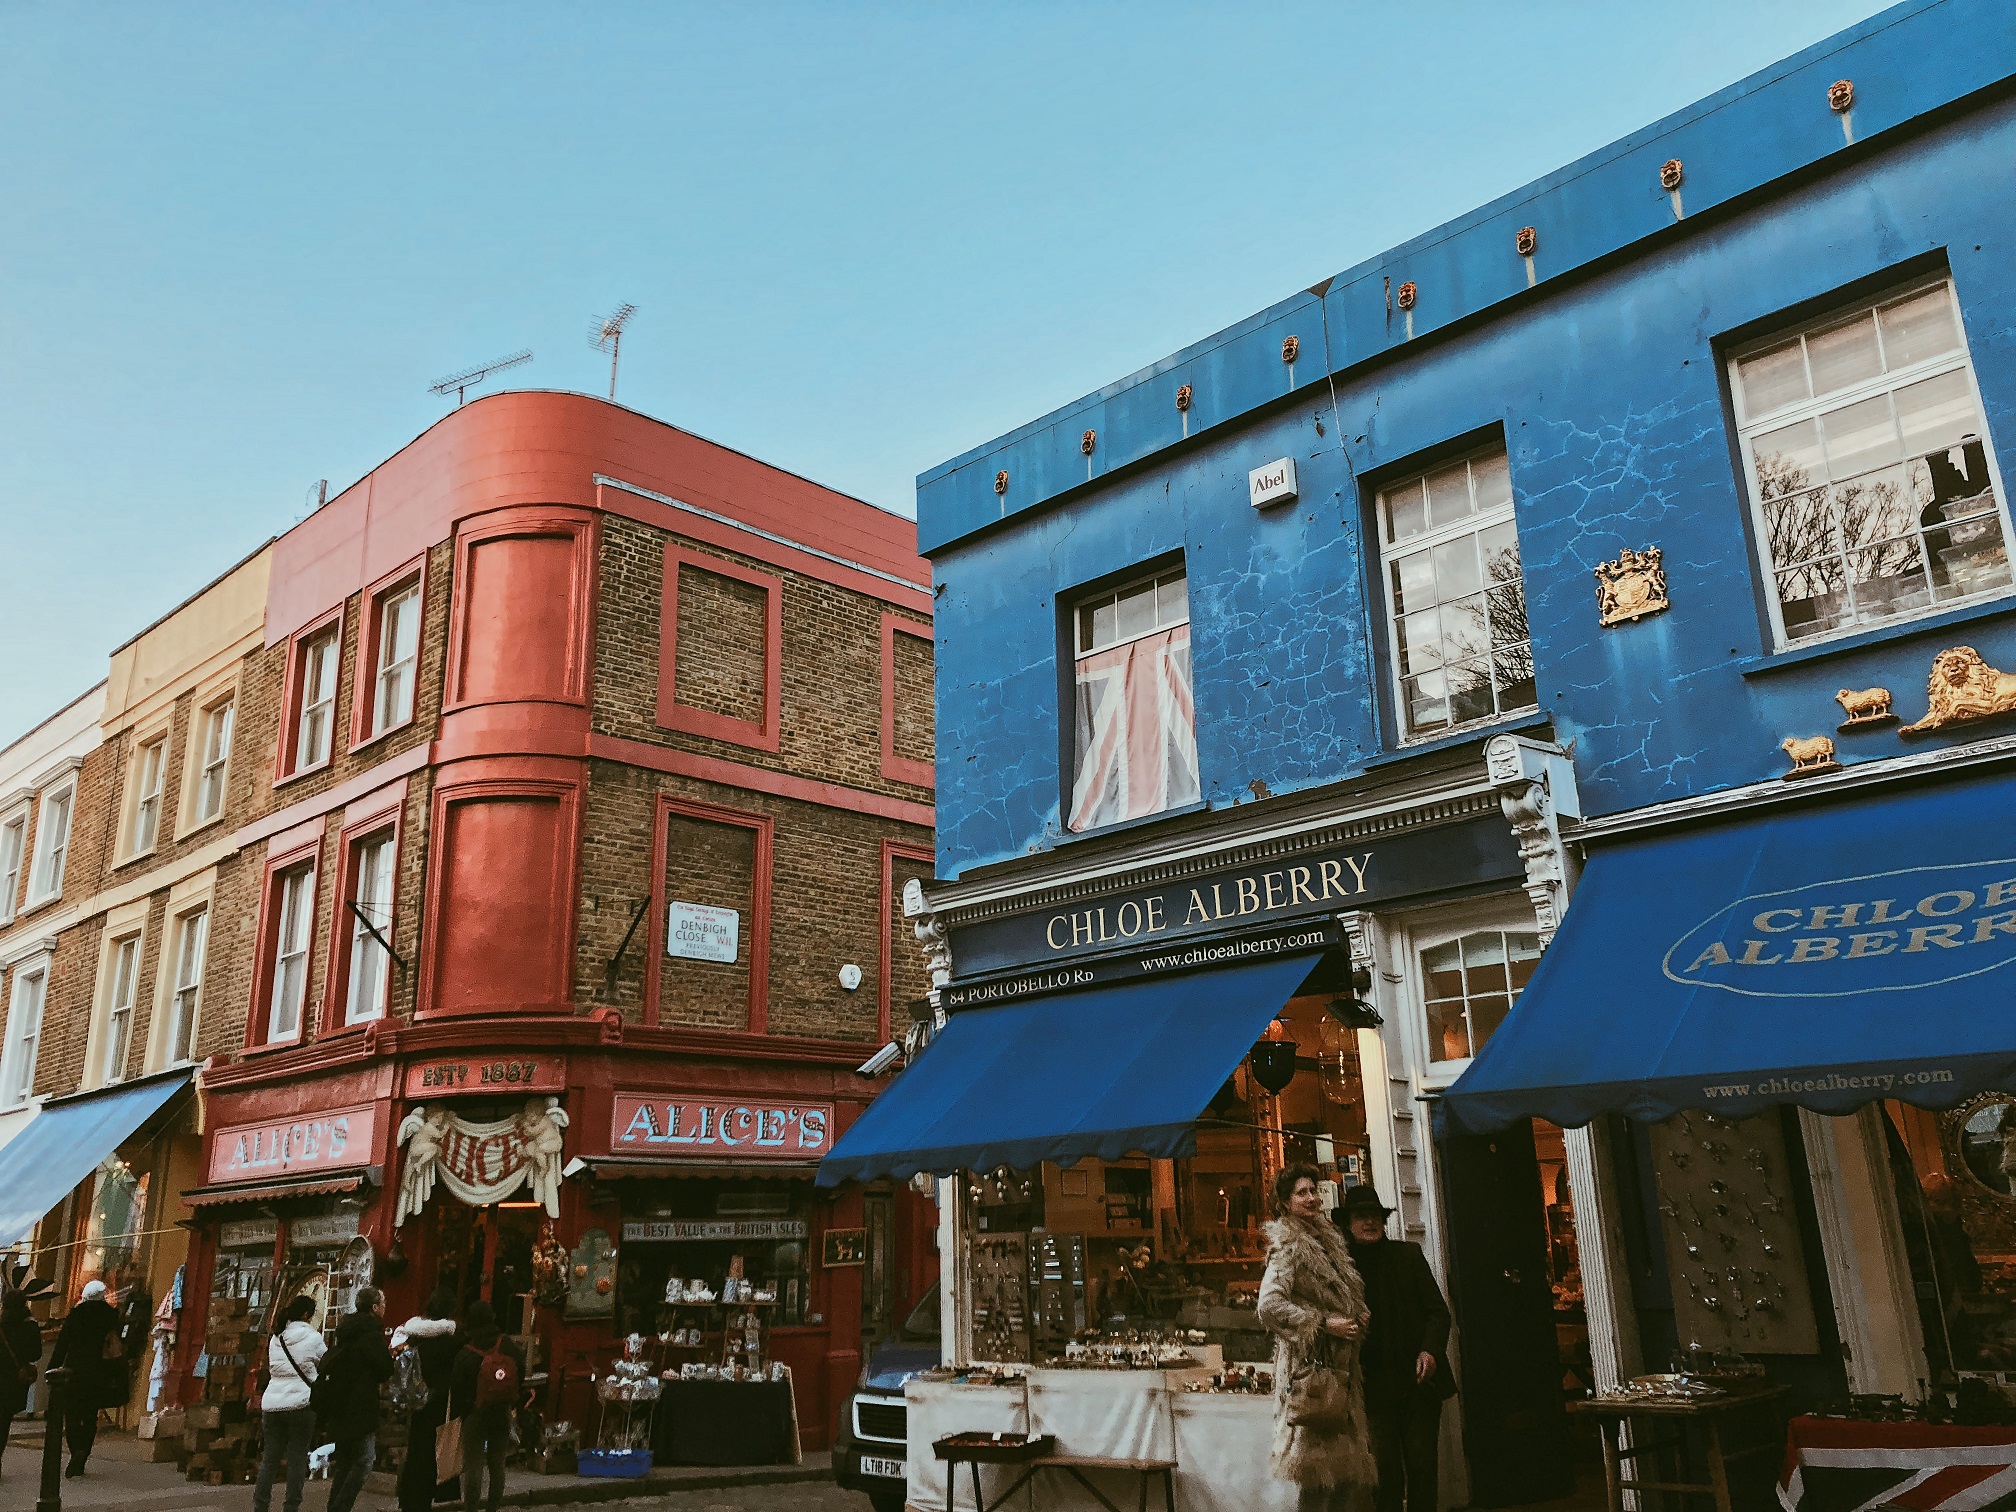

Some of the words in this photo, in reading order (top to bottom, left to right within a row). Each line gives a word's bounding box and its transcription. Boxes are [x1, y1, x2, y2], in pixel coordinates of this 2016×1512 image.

[1254, 469, 1285, 494] Abel
[1045, 895, 1168, 951] CHLOE
[1183, 851, 1375, 926] ALBERRY
[675, 930, 707, 943] CLOSE
[681, 920, 727, 935] DENBIGH
[1140, 930, 1325, 971] www.chloealberry.com
[949, 991, 965, 1005] 84
[968, 971, 1070, 1002] PORTOBELLO
[1703, 1067, 1954, 1099] www.chloealberry.com
[619, 1103, 827, 1149] ALICE'S
[229, 1116, 349, 1171] ALICE'S
[643, 1223, 670, 1237] BEST
[674, 1222, 706, 1237] VALUE
[734, 1223, 772, 1235] BRITISH
[774, 1222, 804, 1235] ISLES
[885, 1462, 902, 1476] FDK
